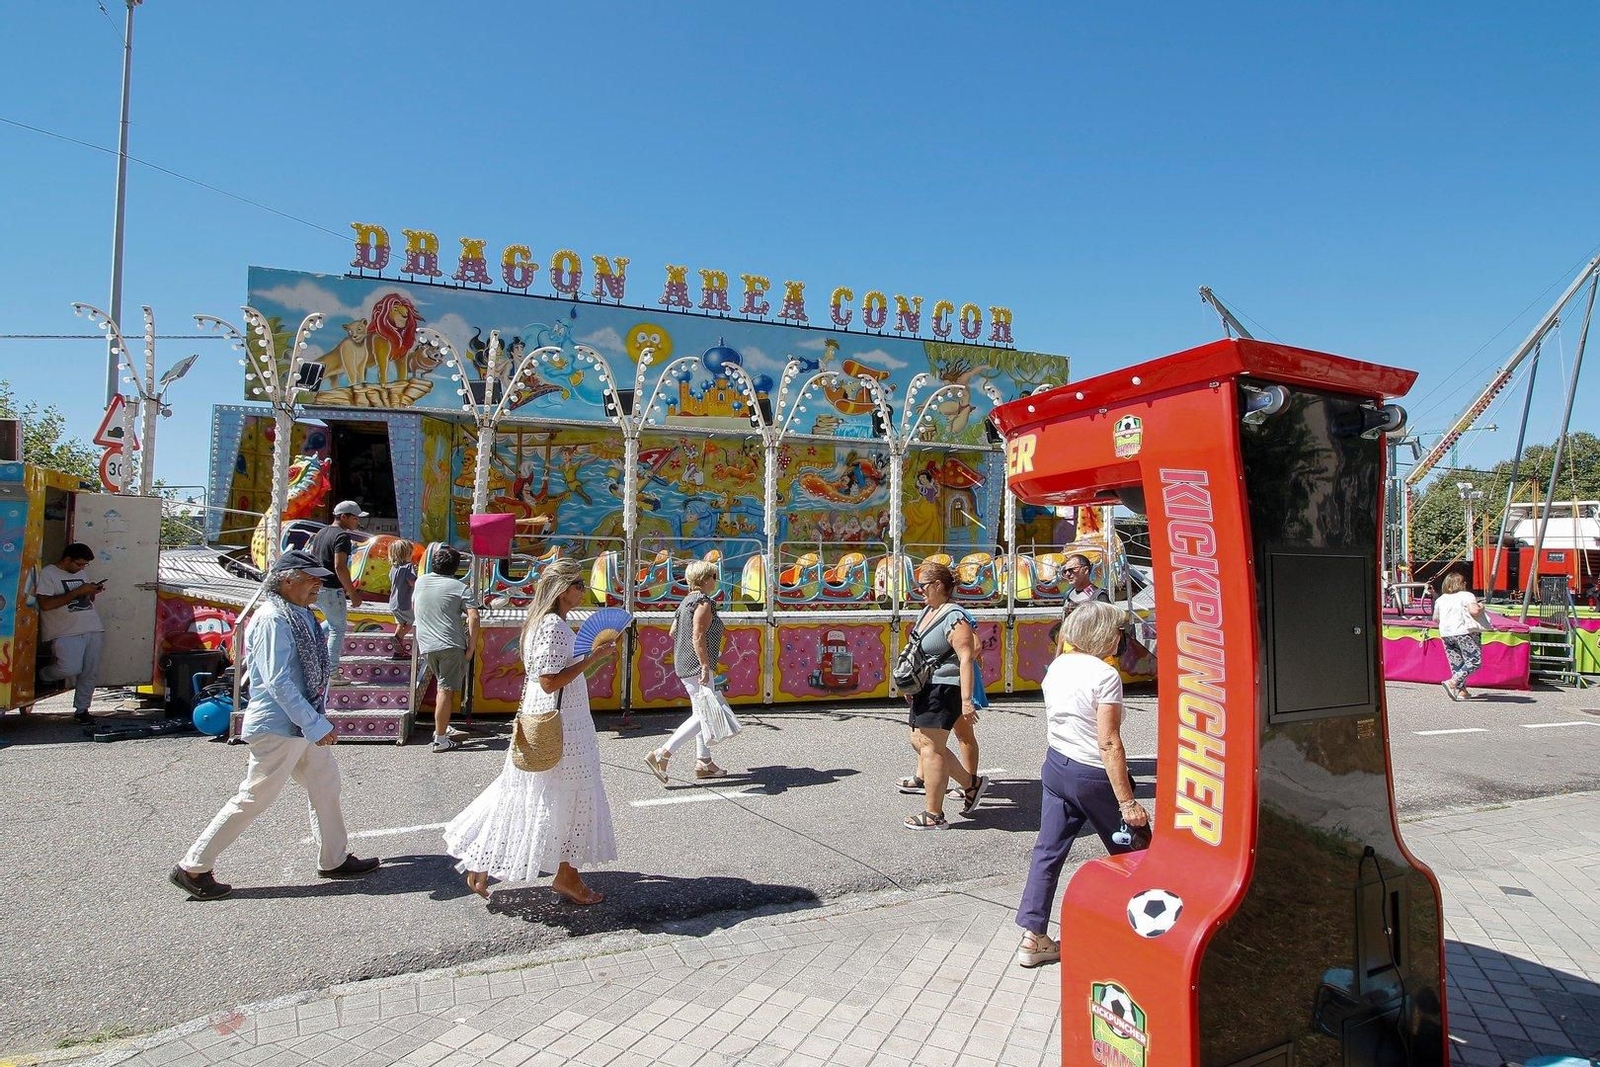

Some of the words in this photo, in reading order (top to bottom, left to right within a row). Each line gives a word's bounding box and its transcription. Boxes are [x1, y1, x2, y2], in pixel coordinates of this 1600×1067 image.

[350, 221, 631, 299] DRAGON
[658, 264, 810, 322] AREA
[829, 285, 1015, 344] CONCOR
[1159, 468, 1226, 847] KICKPUNCHER
